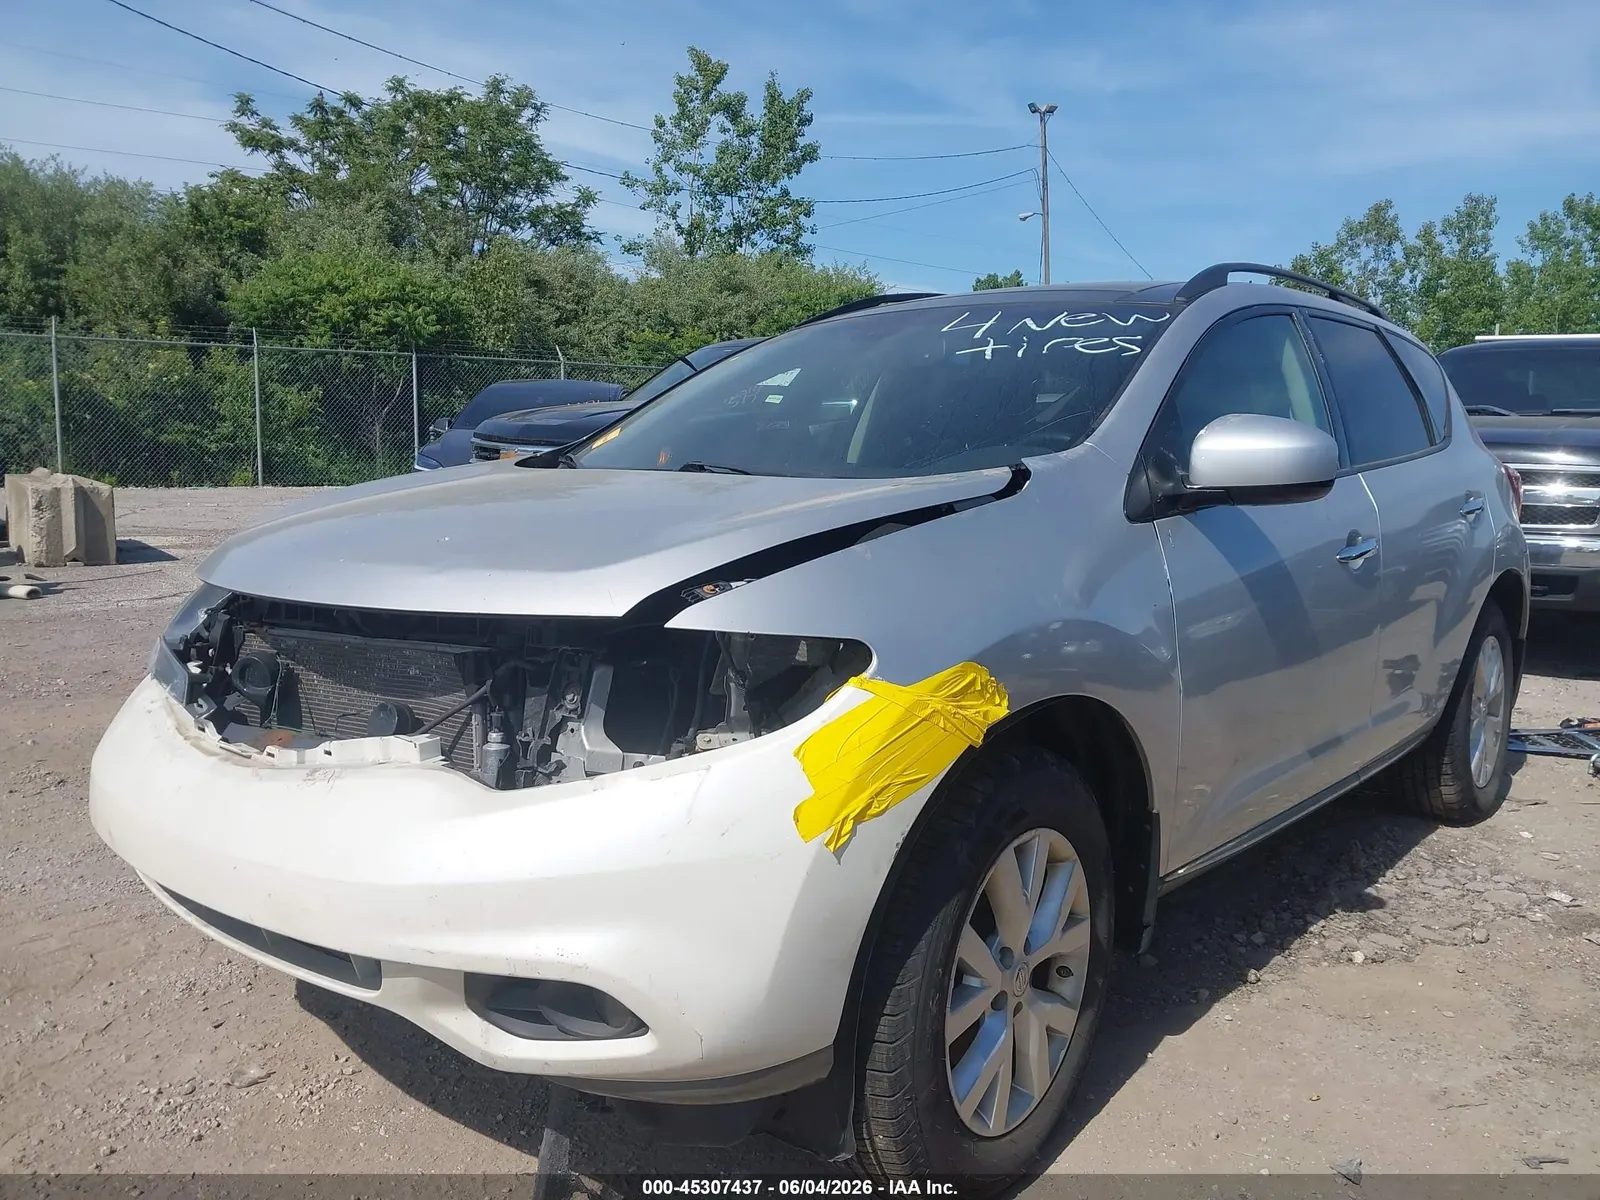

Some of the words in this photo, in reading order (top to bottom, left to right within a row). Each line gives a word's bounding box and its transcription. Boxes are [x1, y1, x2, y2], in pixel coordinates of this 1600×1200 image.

[940, 310, 1002, 339] 4
[1006, 310, 1171, 336] New
[955, 336, 1143, 360] tires
